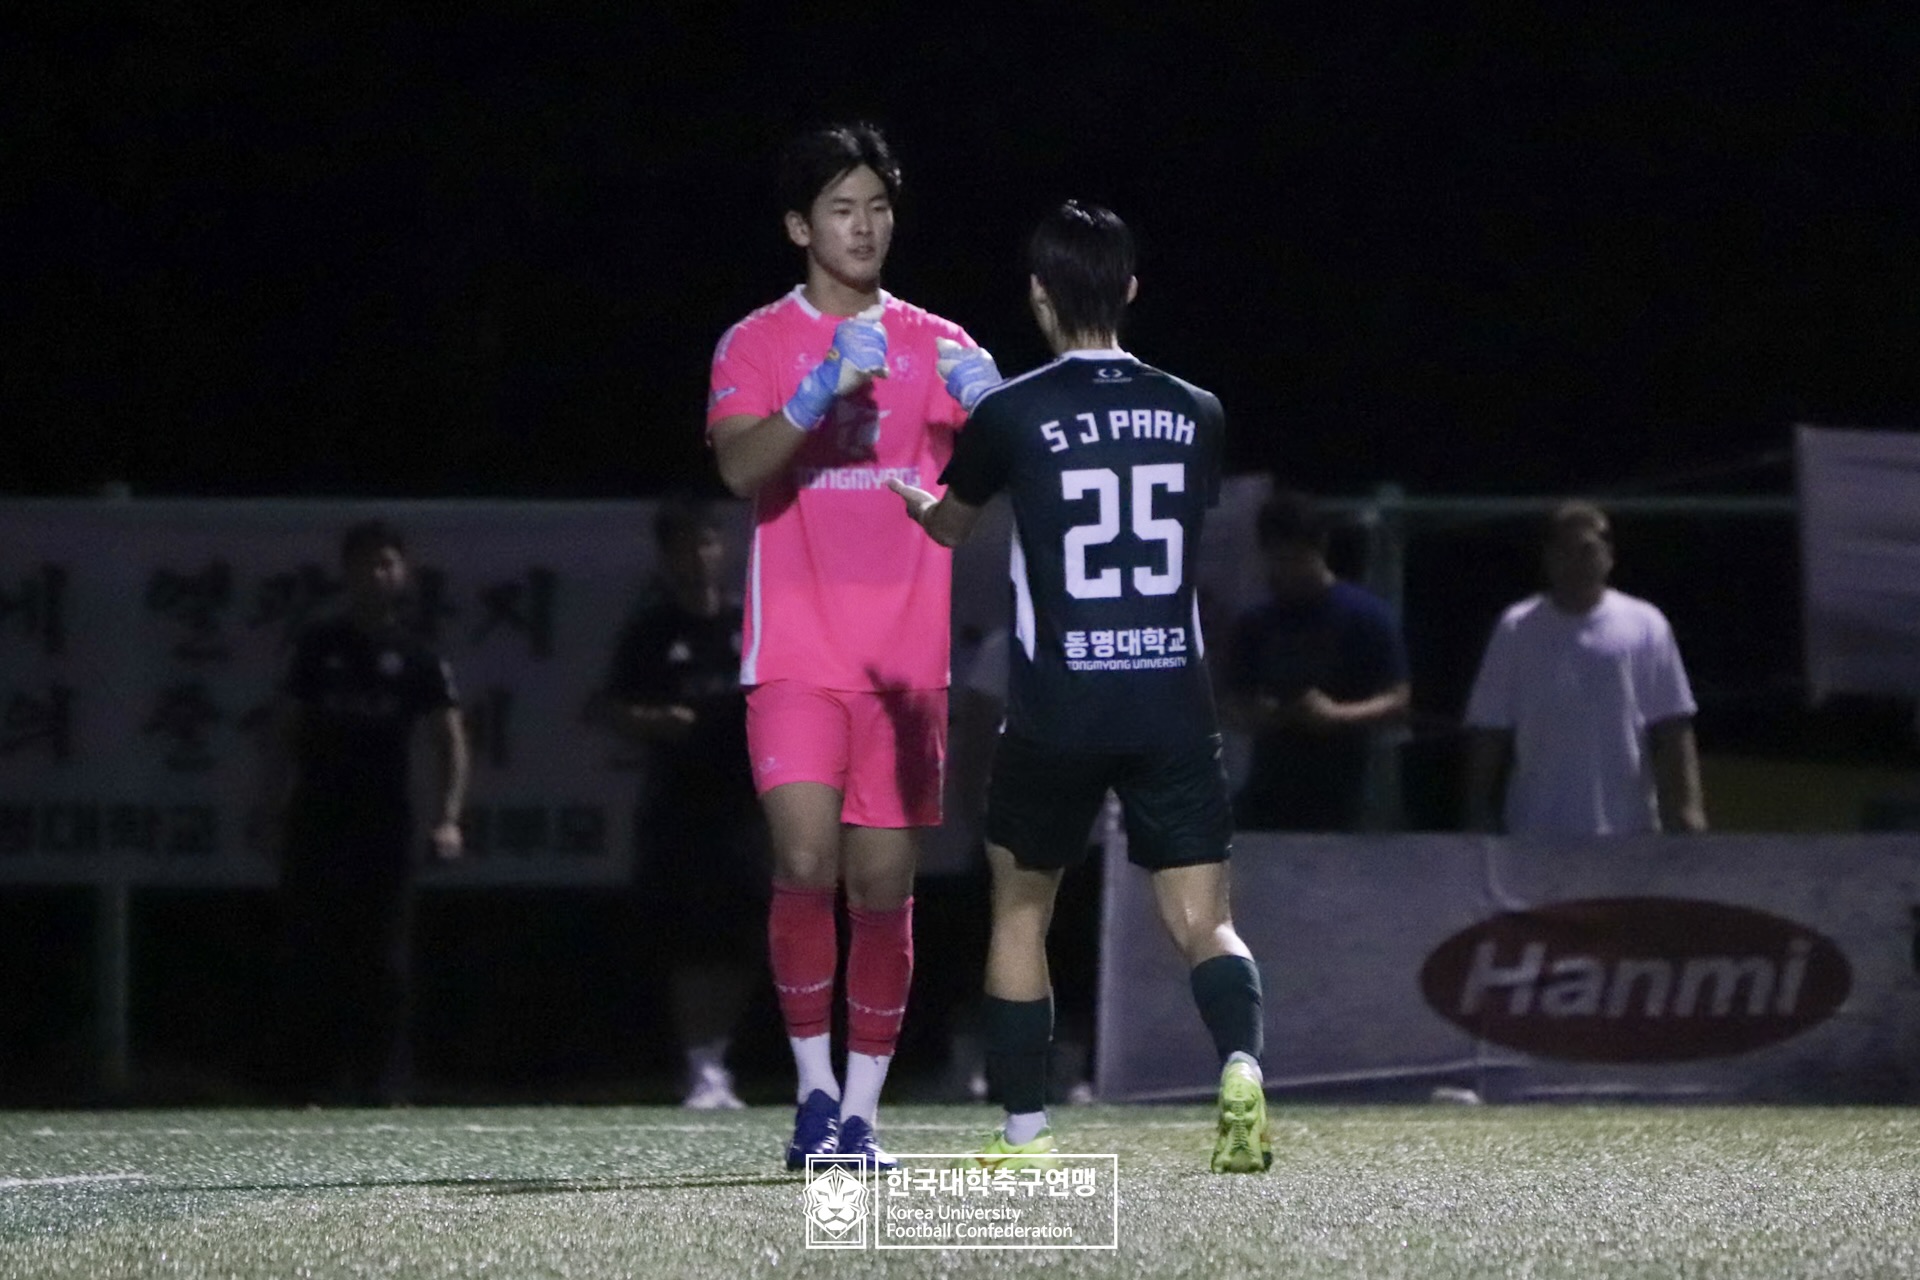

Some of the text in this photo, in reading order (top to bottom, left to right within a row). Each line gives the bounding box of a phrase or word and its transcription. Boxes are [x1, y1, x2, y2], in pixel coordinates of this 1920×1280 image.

[1041, 409, 1196, 453] S J PARK
[1061, 463, 1185, 600] 25
[1064, 627, 1187, 659] 동명대학교
[1066, 656, 1187, 671] TONGMYONG UNIVERSITY
[1459, 939, 1812, 1017] Hanmi
